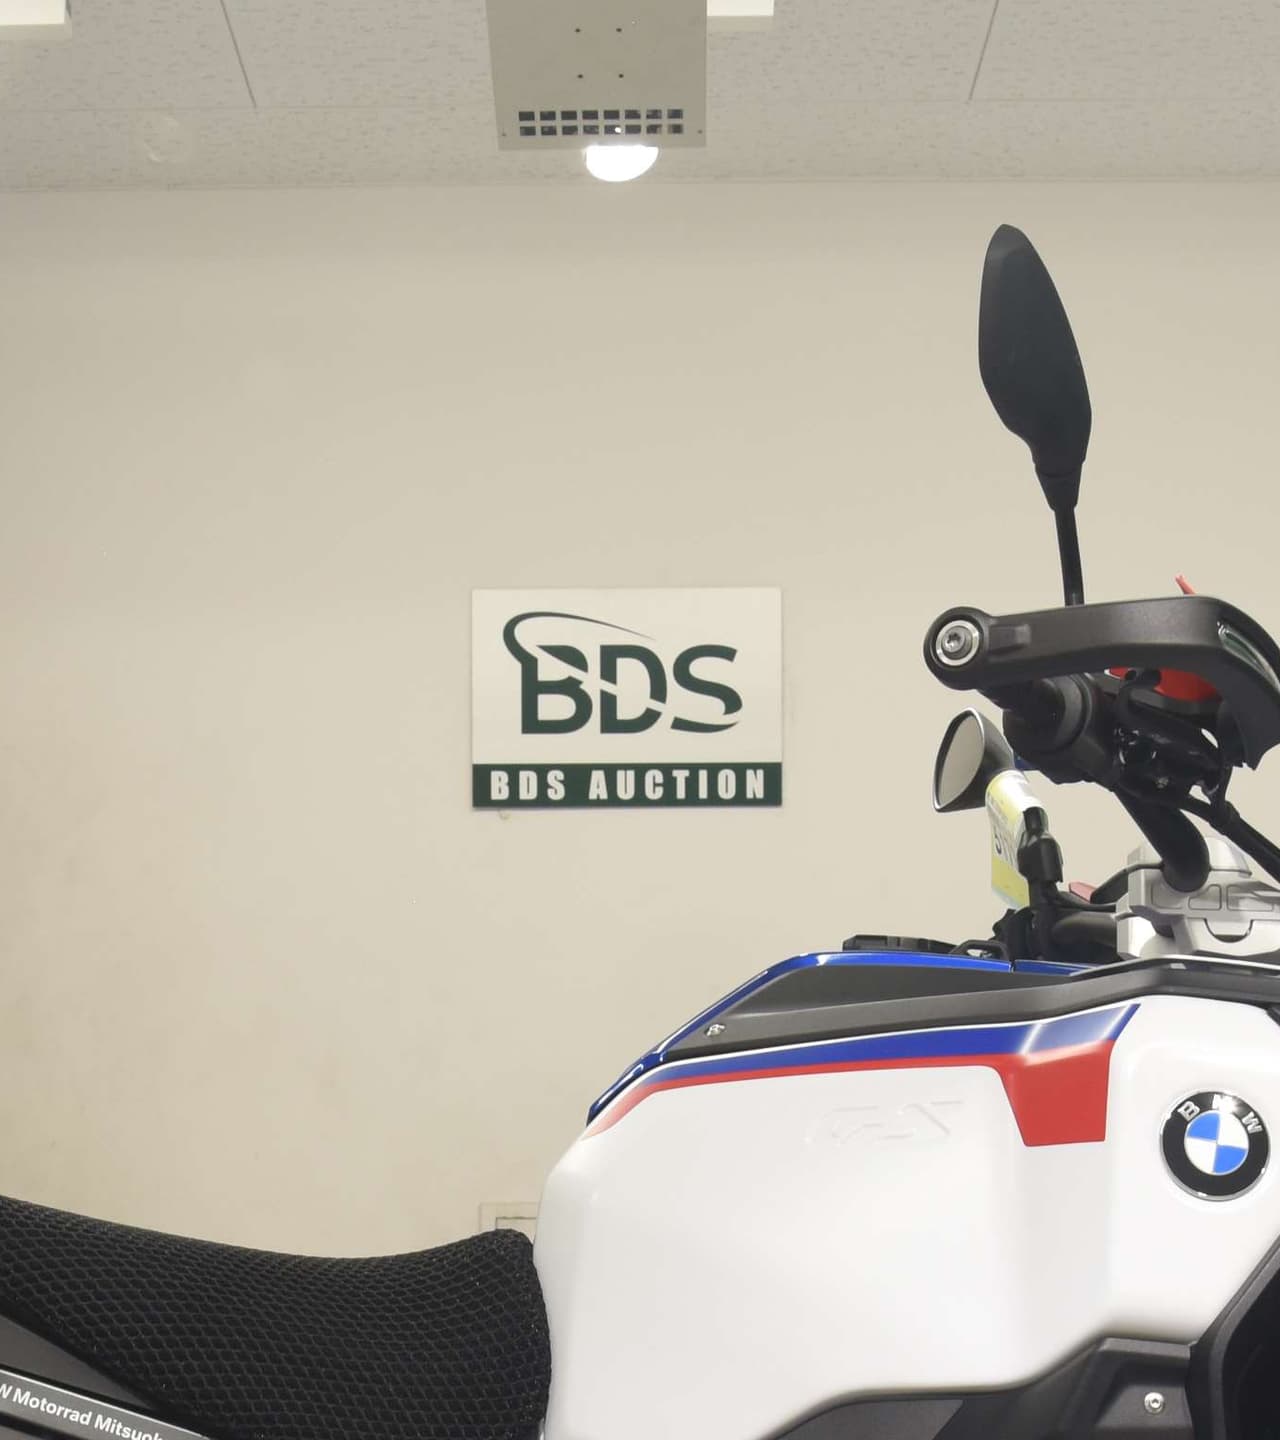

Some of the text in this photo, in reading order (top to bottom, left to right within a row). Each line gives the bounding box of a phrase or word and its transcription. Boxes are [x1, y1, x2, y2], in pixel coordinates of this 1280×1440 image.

[503, 611, 743, 734] BDS
[490, 769, 765, 800] BDS AUCTION
[12, 1388, 93, 1427] Motorrad
